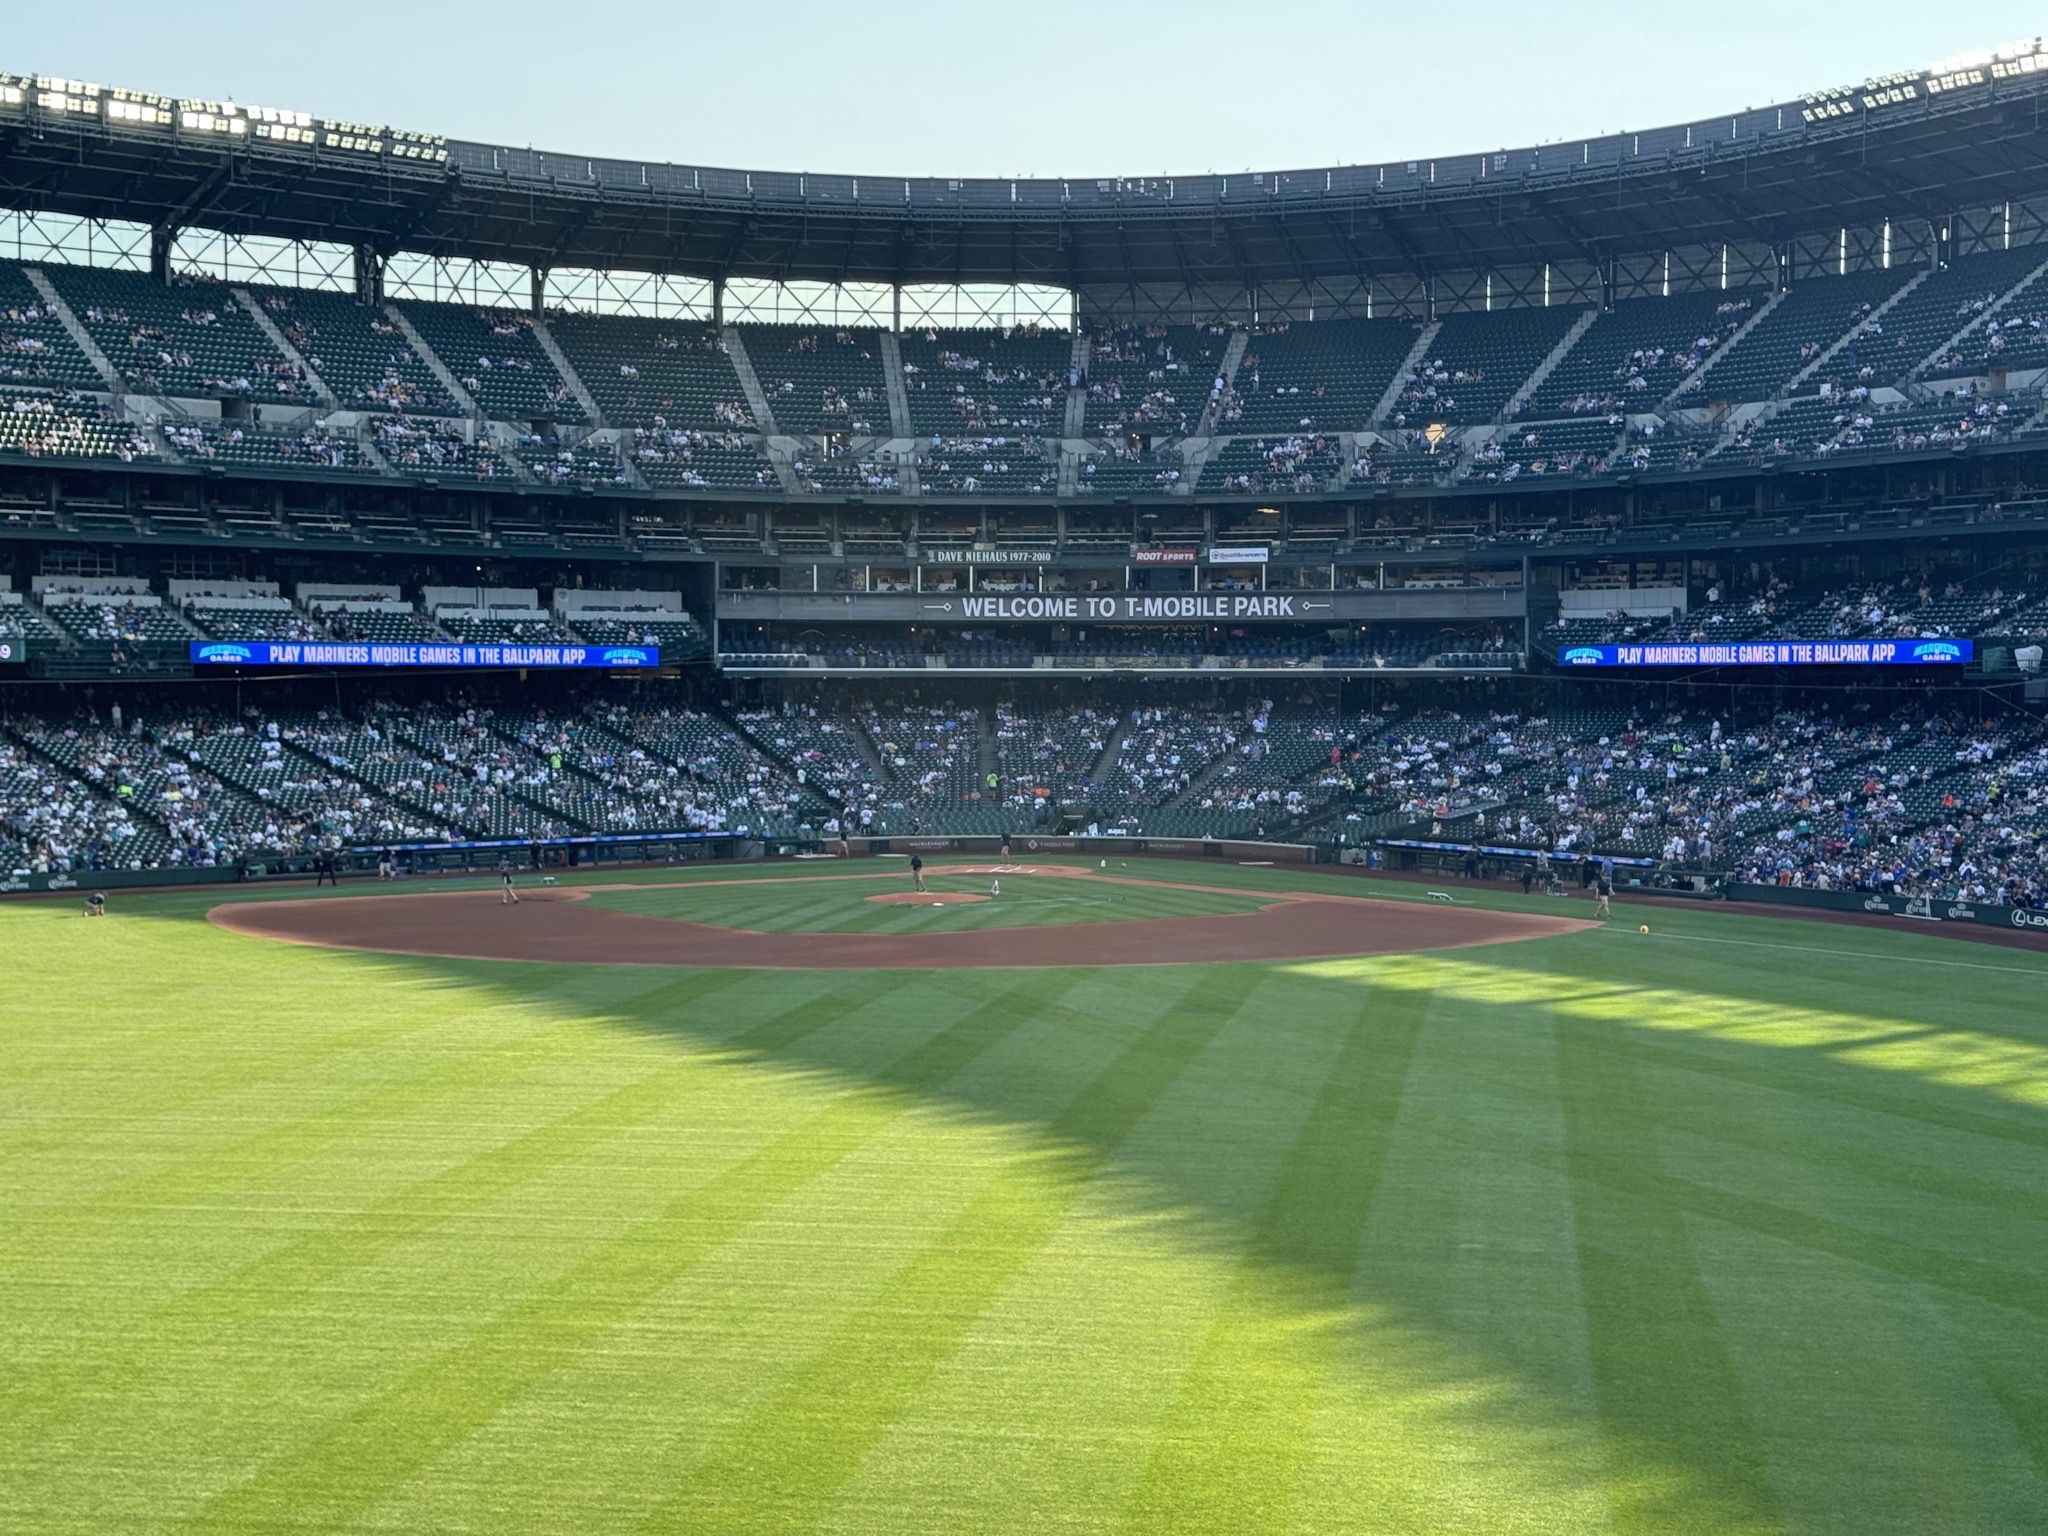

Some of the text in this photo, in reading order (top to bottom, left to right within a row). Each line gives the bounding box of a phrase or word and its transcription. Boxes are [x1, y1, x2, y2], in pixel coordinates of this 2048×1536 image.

[938, 551, 1051, 562] DAVE NIEHAUS 1977-2010
[1136, 552, 1162, 561] ROOT
[962, 596, 1294, 618] WELCOME TO T-MOBILE PARK
[269, 645, 587, 665] PLAY MARINERS MOBILE GAMES IN THE BALLPARK APP
[1617, 643, 1896, 664] PLAY MARINERS MOBILE GAMES IN THE BALLPARK APP
[1922, 653, 1952, 662] GAMES
[1572, 657, 1597, 665] GAMES
[48, 879, 78, 890] Corona
[1864, 900, 1890, 911] Corona
[1948, 906, 1975, 918] Corona
